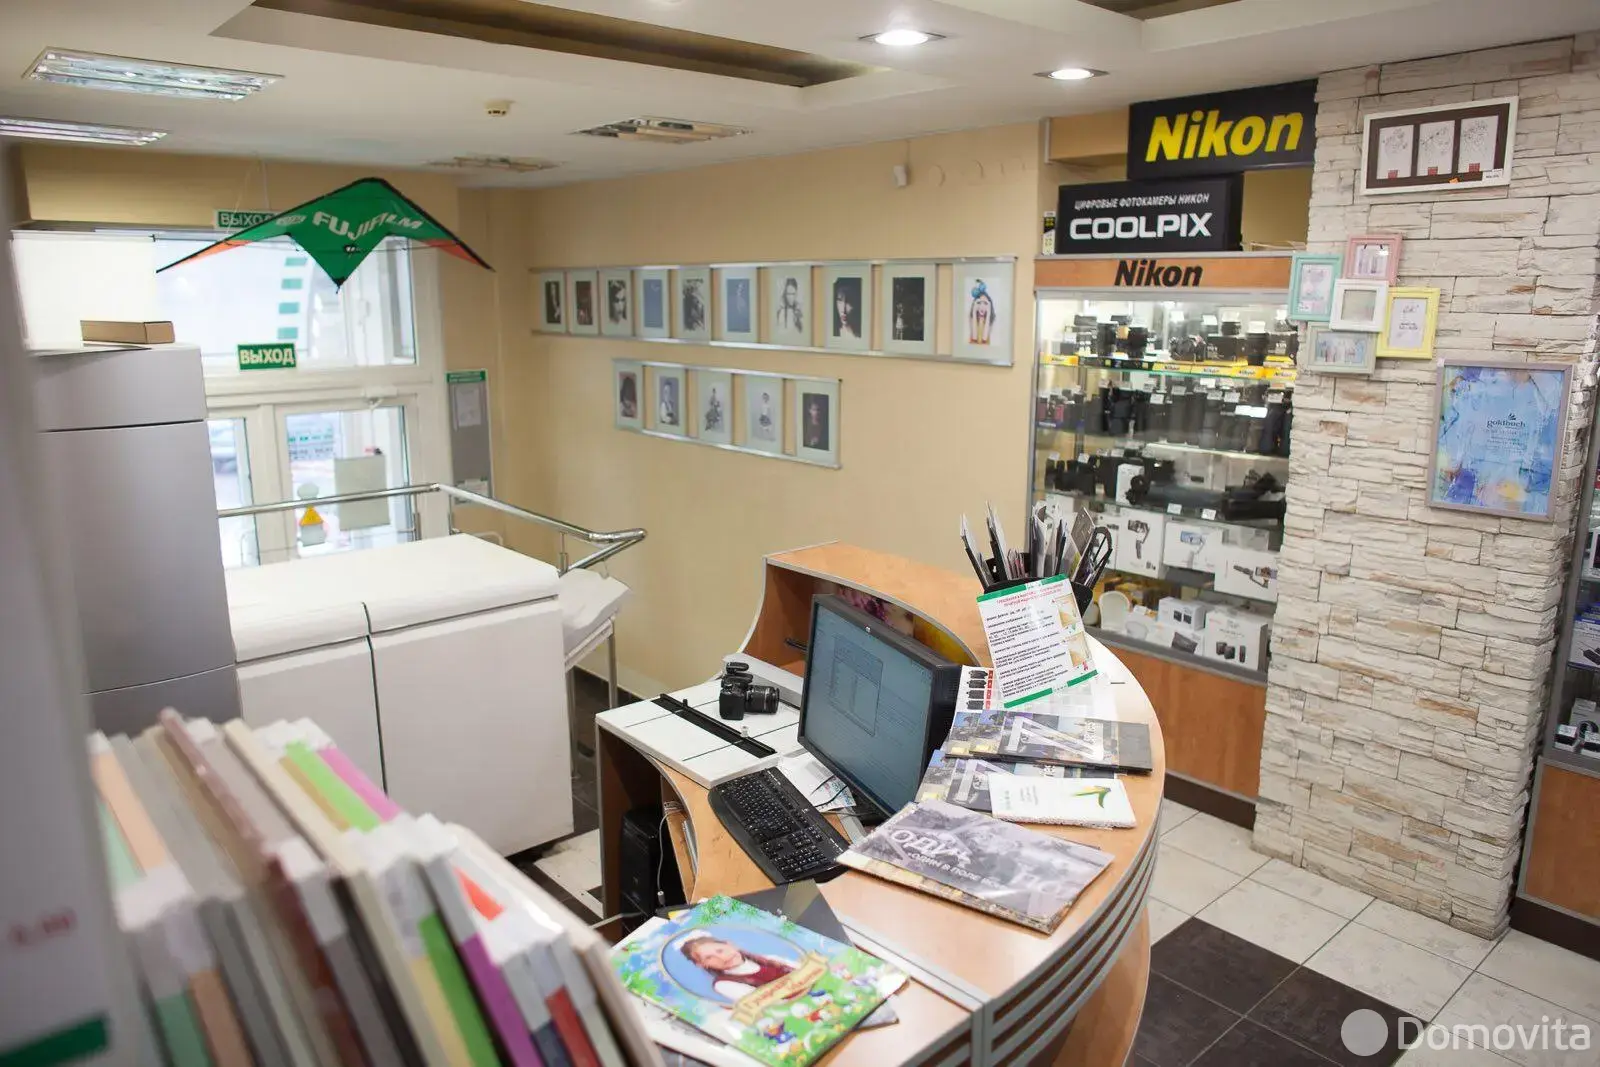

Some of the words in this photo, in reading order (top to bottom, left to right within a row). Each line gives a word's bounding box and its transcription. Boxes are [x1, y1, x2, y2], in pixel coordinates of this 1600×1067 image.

[1145, 110, 1304, 162] Nikon
[1074, 199, 1118, 211] ЦИФРОВЫЕ
[1119, 195, 1177, 208] ФОТОКАМЕРЫ
[1178, 193, 1210, 205] НИКОН
[312, 211, 423, 241] FUJIFILM
[1069, 212, 1213, 240] COOLPIX
[1114, 259, 1203, 287] Nikon
[239, 349, 294, 366] ВЫХОД
